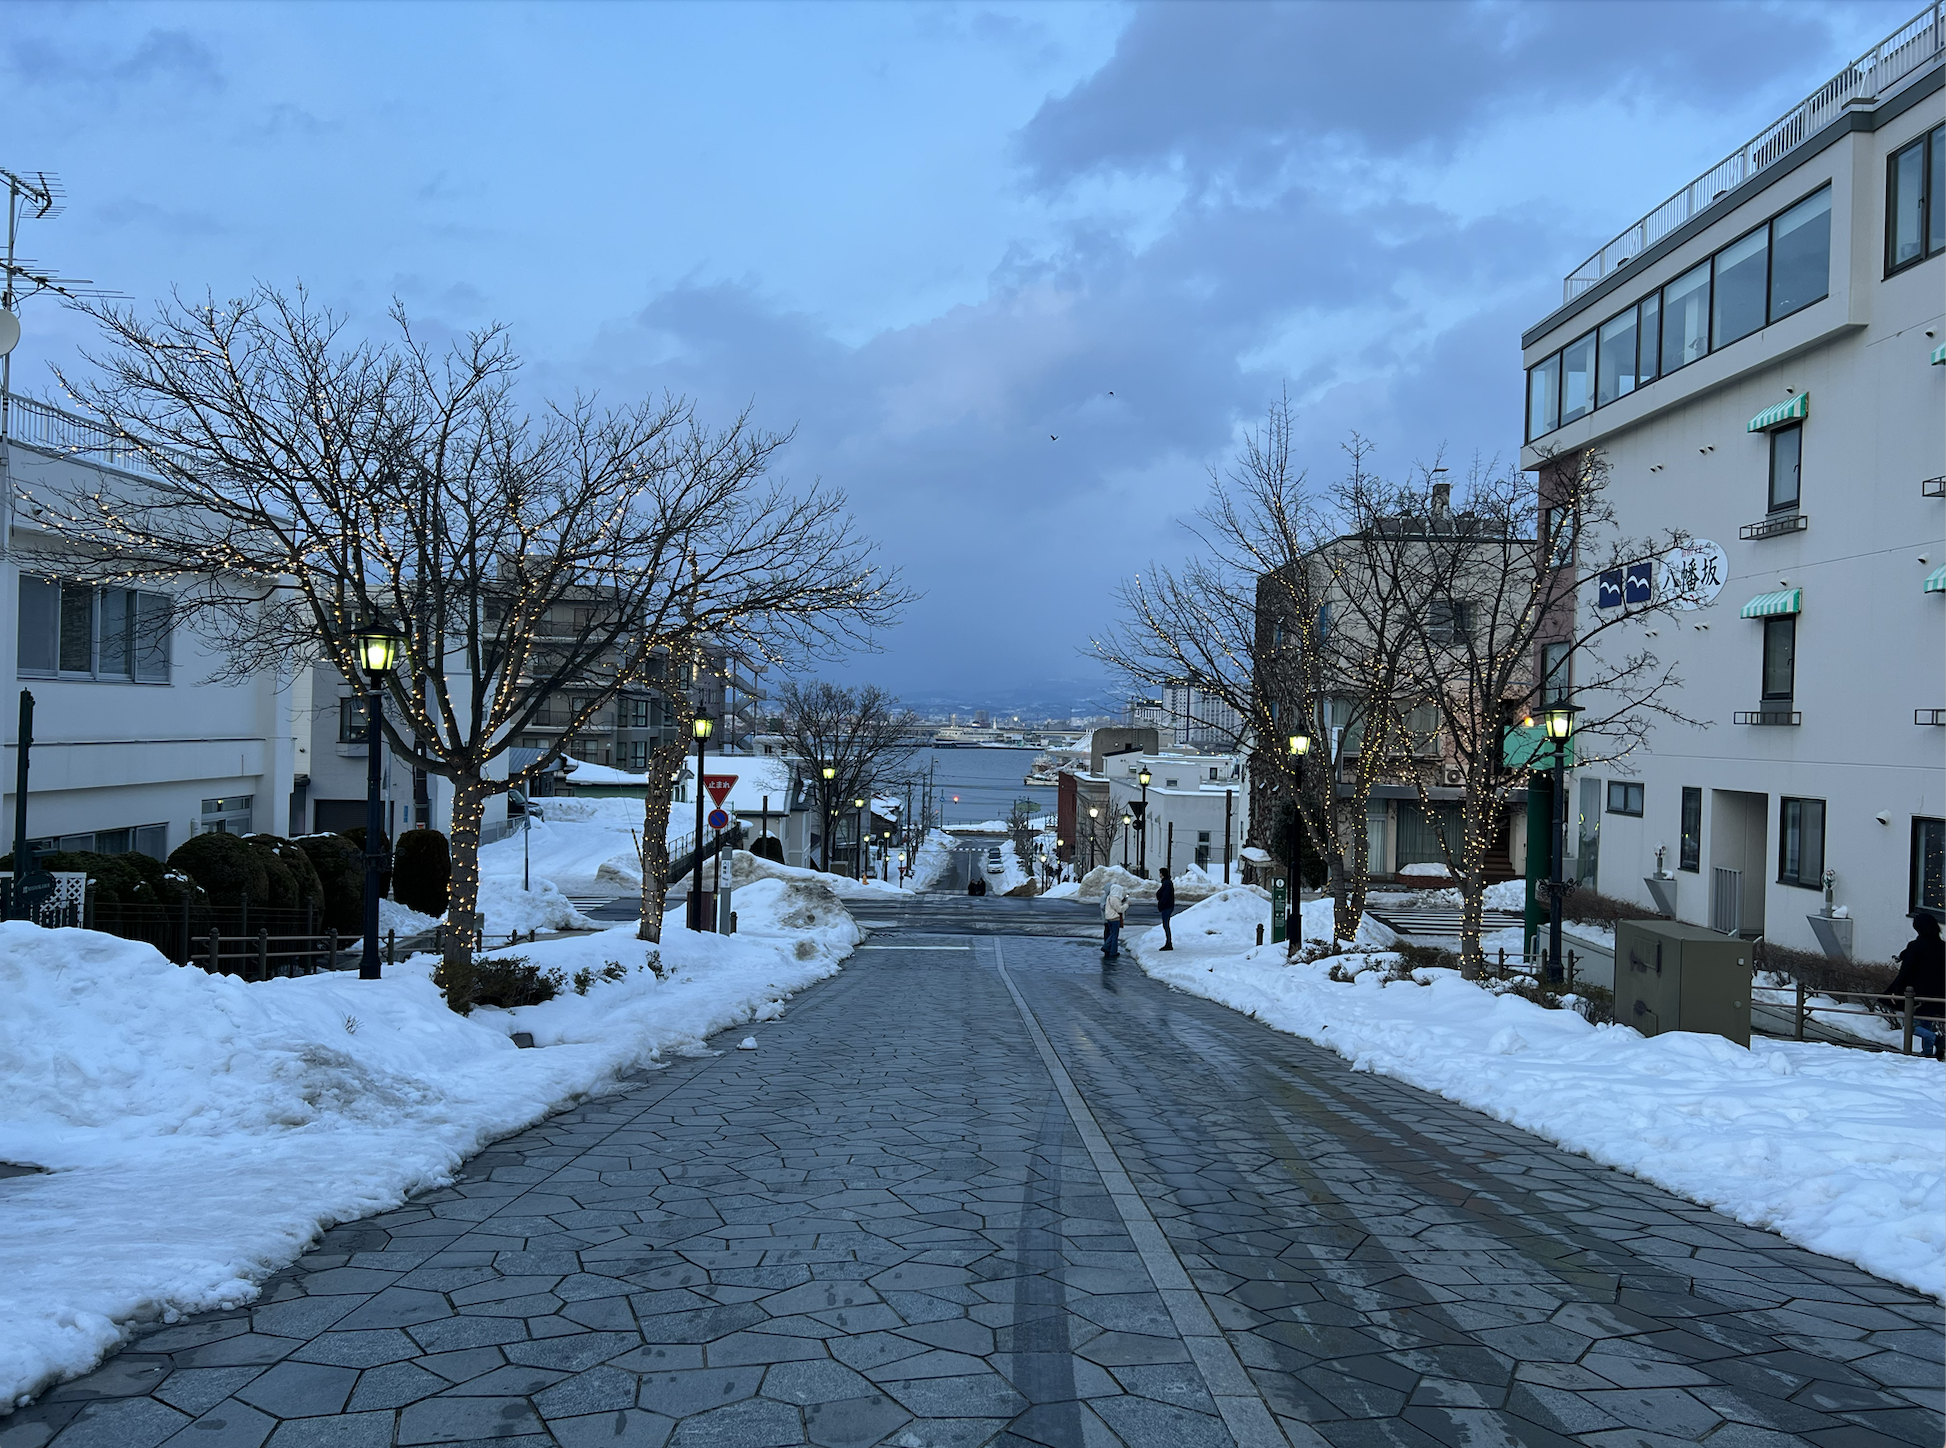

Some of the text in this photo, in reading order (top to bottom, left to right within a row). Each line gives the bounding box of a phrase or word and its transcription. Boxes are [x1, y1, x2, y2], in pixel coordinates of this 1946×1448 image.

[1663, 556, 1721, 593] 八幡坂
[708, 780, 730, 789] 止まれ
